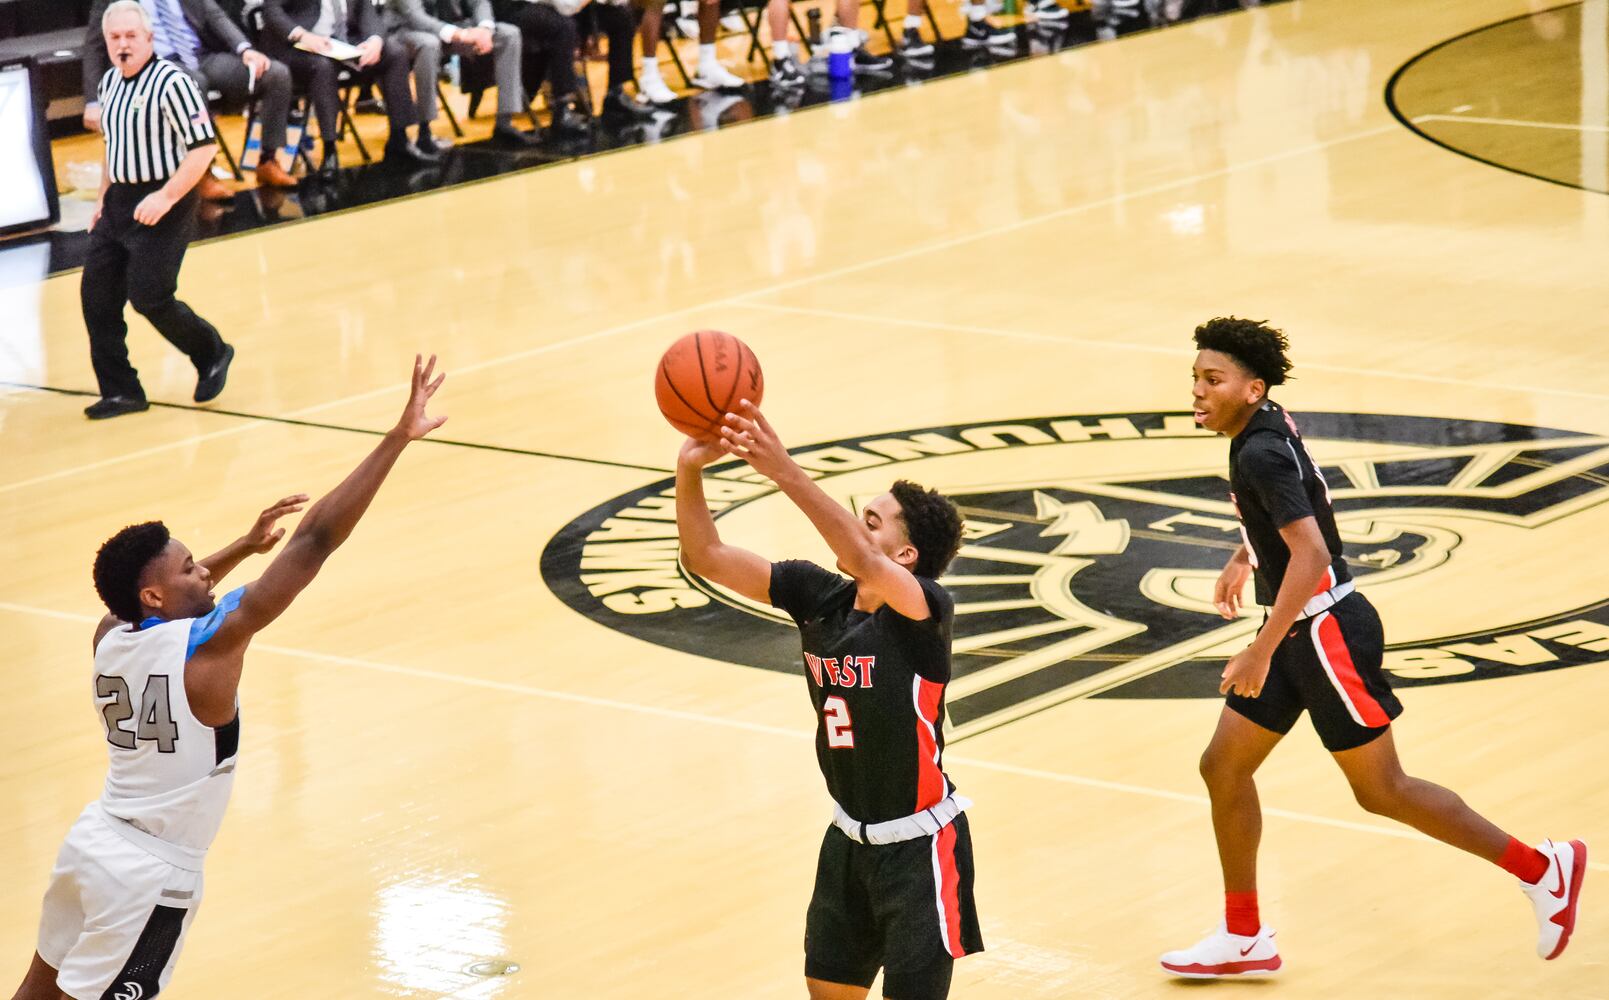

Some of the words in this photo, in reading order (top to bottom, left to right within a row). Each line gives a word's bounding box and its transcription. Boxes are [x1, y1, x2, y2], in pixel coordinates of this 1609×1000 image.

[803, 651, 876, 688] WEST
[1381, 619, 1609, 679] EAS
[95, 674, 179, 753] 24
[823, 695, 854, 749] 2
